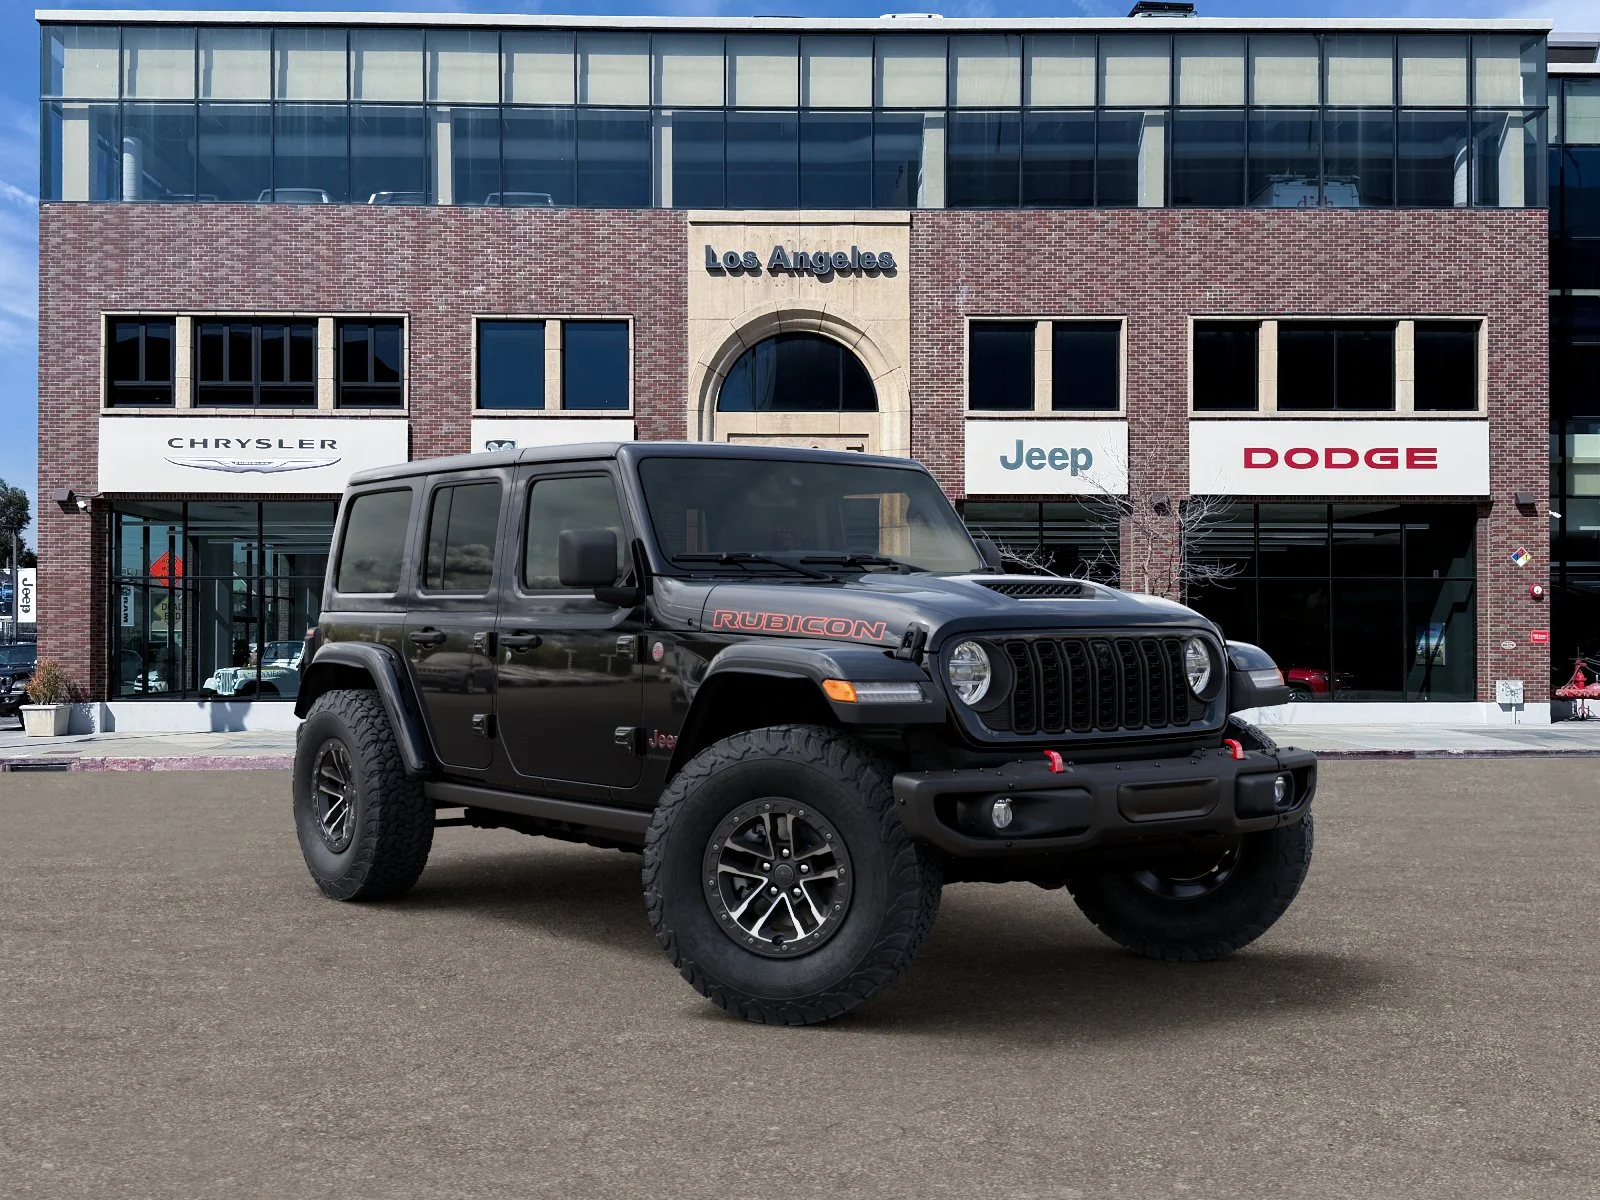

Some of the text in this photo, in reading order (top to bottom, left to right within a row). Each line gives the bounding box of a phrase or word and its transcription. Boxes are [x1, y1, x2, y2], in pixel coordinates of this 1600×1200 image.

[705, 245, 896, 276] Los Angeles
[167, 438, 338, 450] CHRYSLER
[1000, 439, 1093, 476] Jeep
[1243, 447, 1438, 469] DODGE
[20, 578, 34, 614] Jeep
[164, 612, 181, 620] ED
[713, 610, 886, 640] RUBICON
